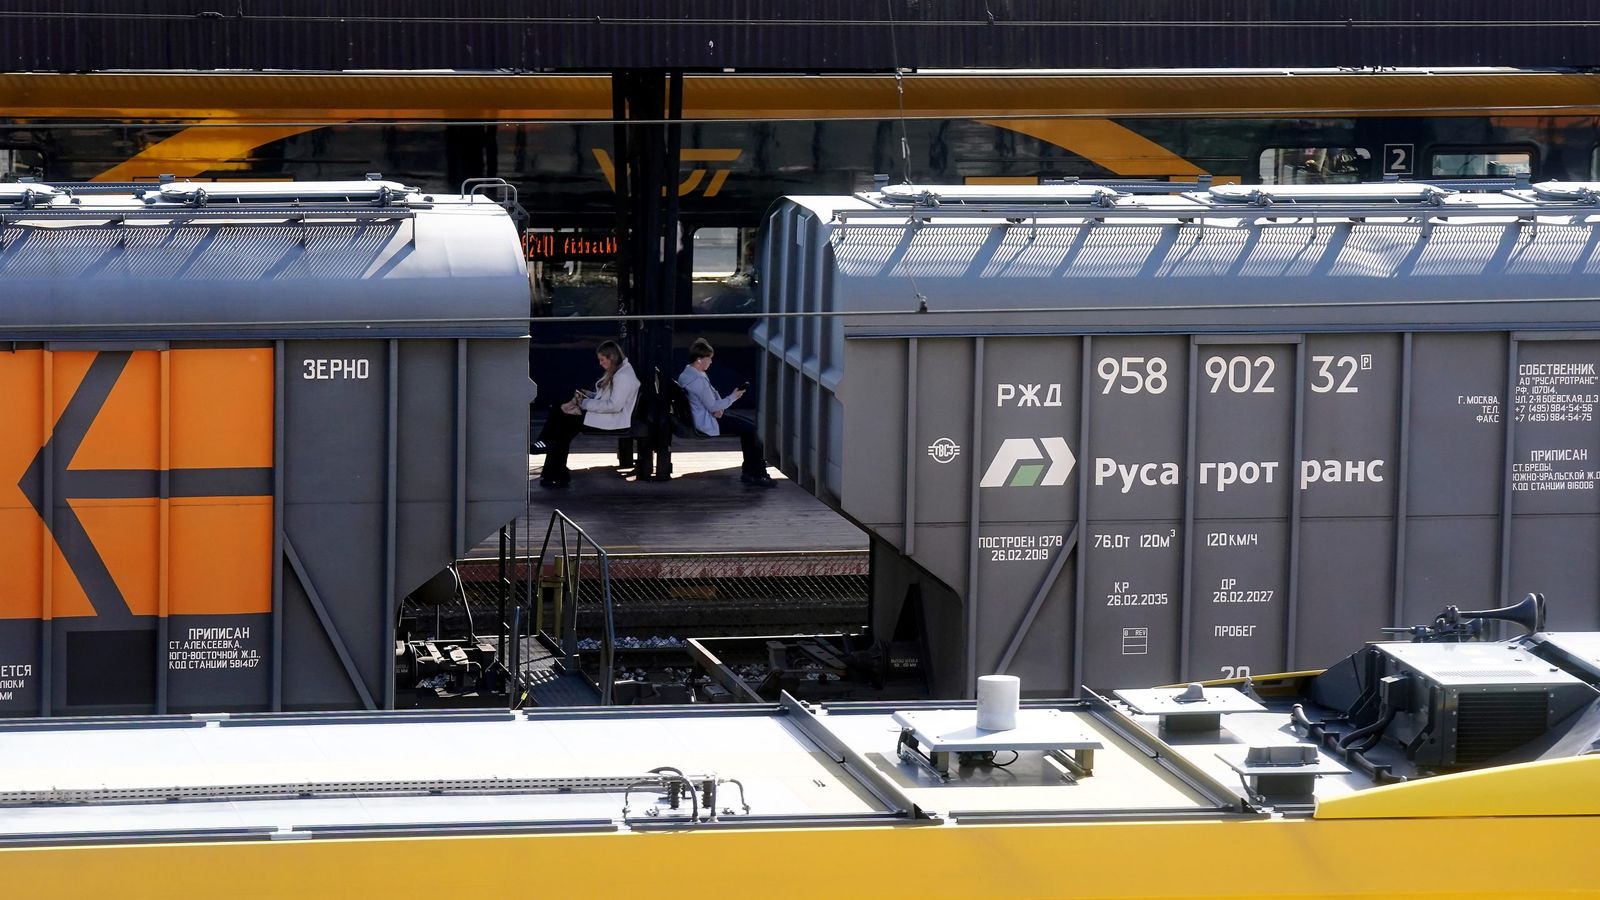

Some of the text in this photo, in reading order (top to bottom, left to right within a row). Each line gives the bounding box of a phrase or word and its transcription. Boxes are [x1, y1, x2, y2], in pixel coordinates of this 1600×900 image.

[1391, 149, 1406, 170] 2
[304, 359, 368, 379] ЗЕРНО
[1520, 364, 1595, 375] СОБСТВЕННИК
[1098, 357, 1167, 394] 958
[1206, 356, 1274, 393] 902
[1312, 356, 1358, 393] 32
[1519, 377, 1598, 385] АО "РУСАГРОТРАНС"
[998, 384, 1062, 406] РЖД
[1515, 405, 1525, 413] +7
[1551, 404, 1592, 412] 984-54-56
[1515, 414, 1525, 422] +7
[1550, 413, 1591, 421] 984-54-75
[1531, 449, 1587, 461] ПРИПИСАН
[1513, 470, 1584, 481] ЮЖНО-УРАЛЬСКОЙ
[1531, 482, 1565, 490] СТАНЦИИ
[1568, 481, 1593, 489] 816006
[979, 536, 1062, 548] ПОСТРОЕН 1378
[1208, 533, 1227, 546] 120
[992, 549, 1048, 561] 26.02.2019
[1115, 582, 1129, 593] КР
[1221, 579, 1236, 589] ДР
[1107, 592, 1167, 605] 26.02.2035
[1213, 591, 1273, 602] 26.02.2027
[189, 627, 249, 639] ПРИПИСАН
[1215, 626, 1256, 636] ПРОБЕГ
[169, 648, 237, 660] ЮГО-ВОСТОЧНОЙ
[169, 659, 259, 669] КОД СТАНЦИИ 581407
